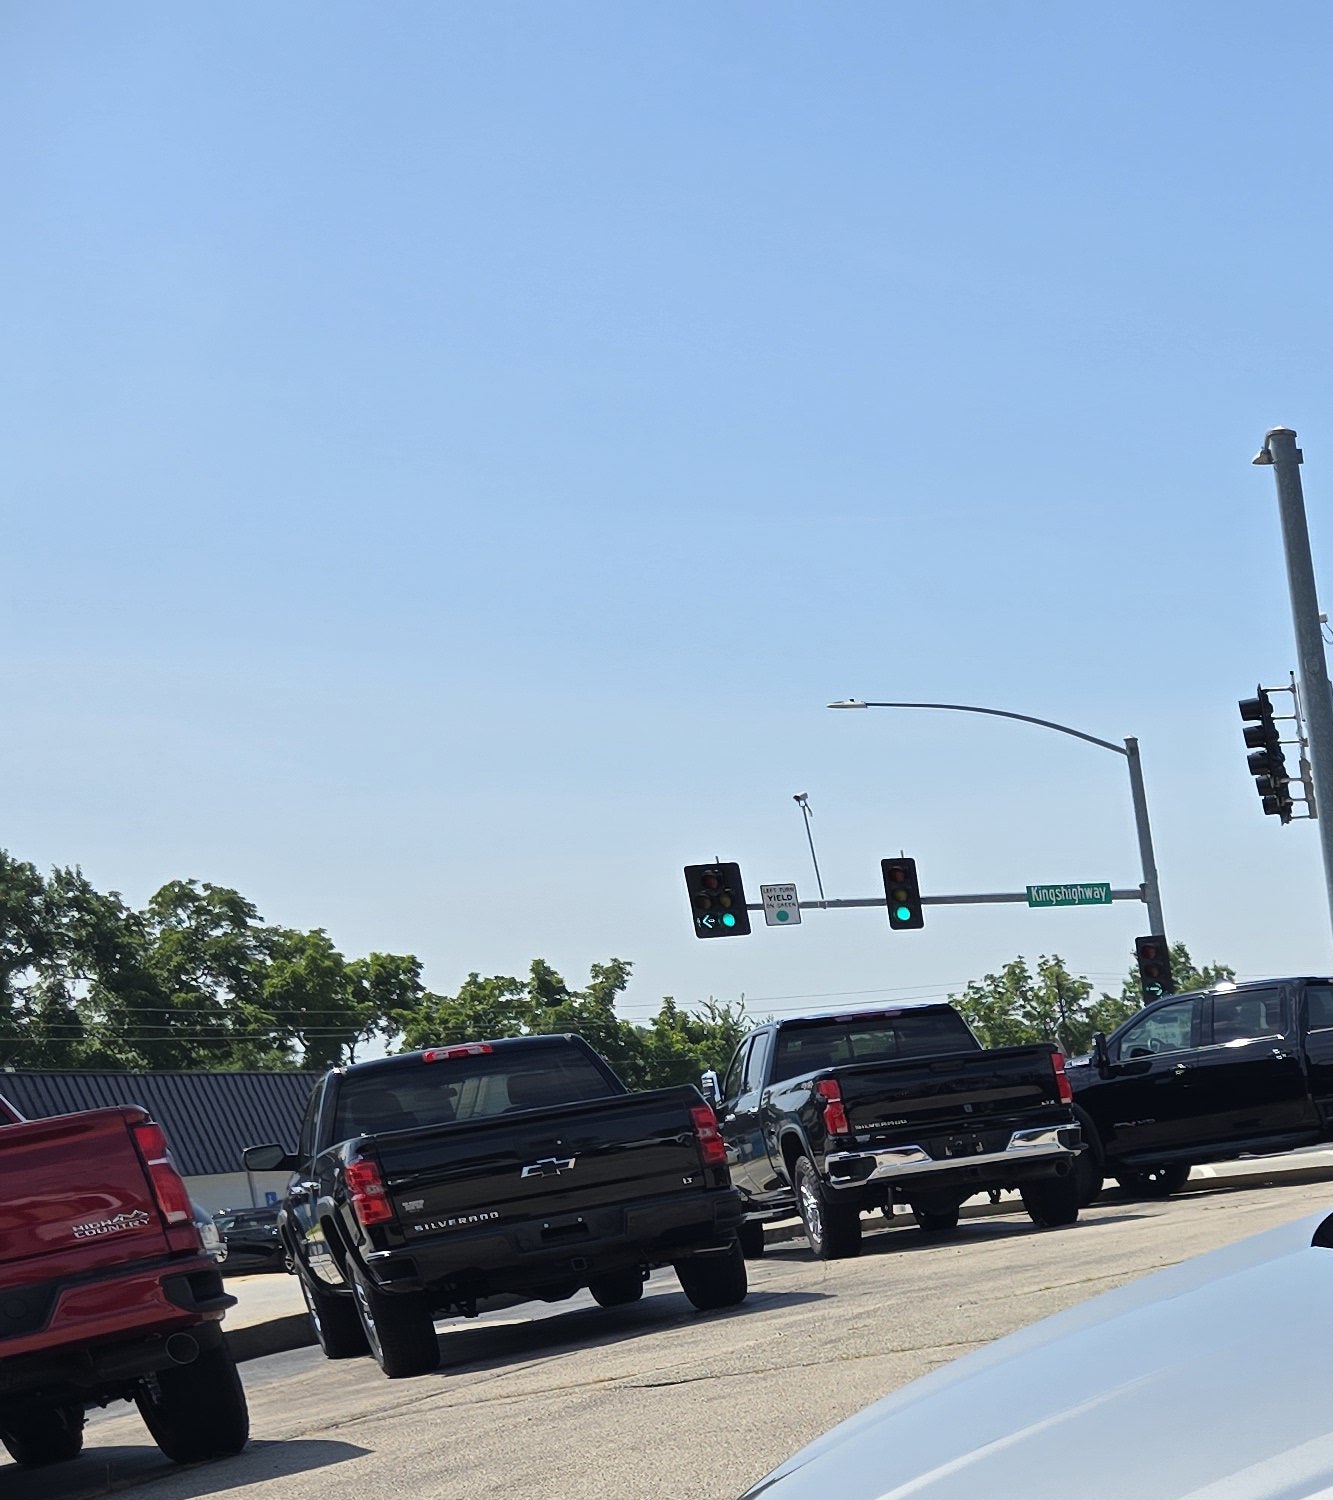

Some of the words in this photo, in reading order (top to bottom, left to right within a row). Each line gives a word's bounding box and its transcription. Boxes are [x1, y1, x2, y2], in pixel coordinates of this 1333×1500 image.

[1031, 885, 1106, 904] Kingshighway
[74, 1218, 150, 1238] COUNTRY
[414, 1211, 500, 1232] SILVERADO
